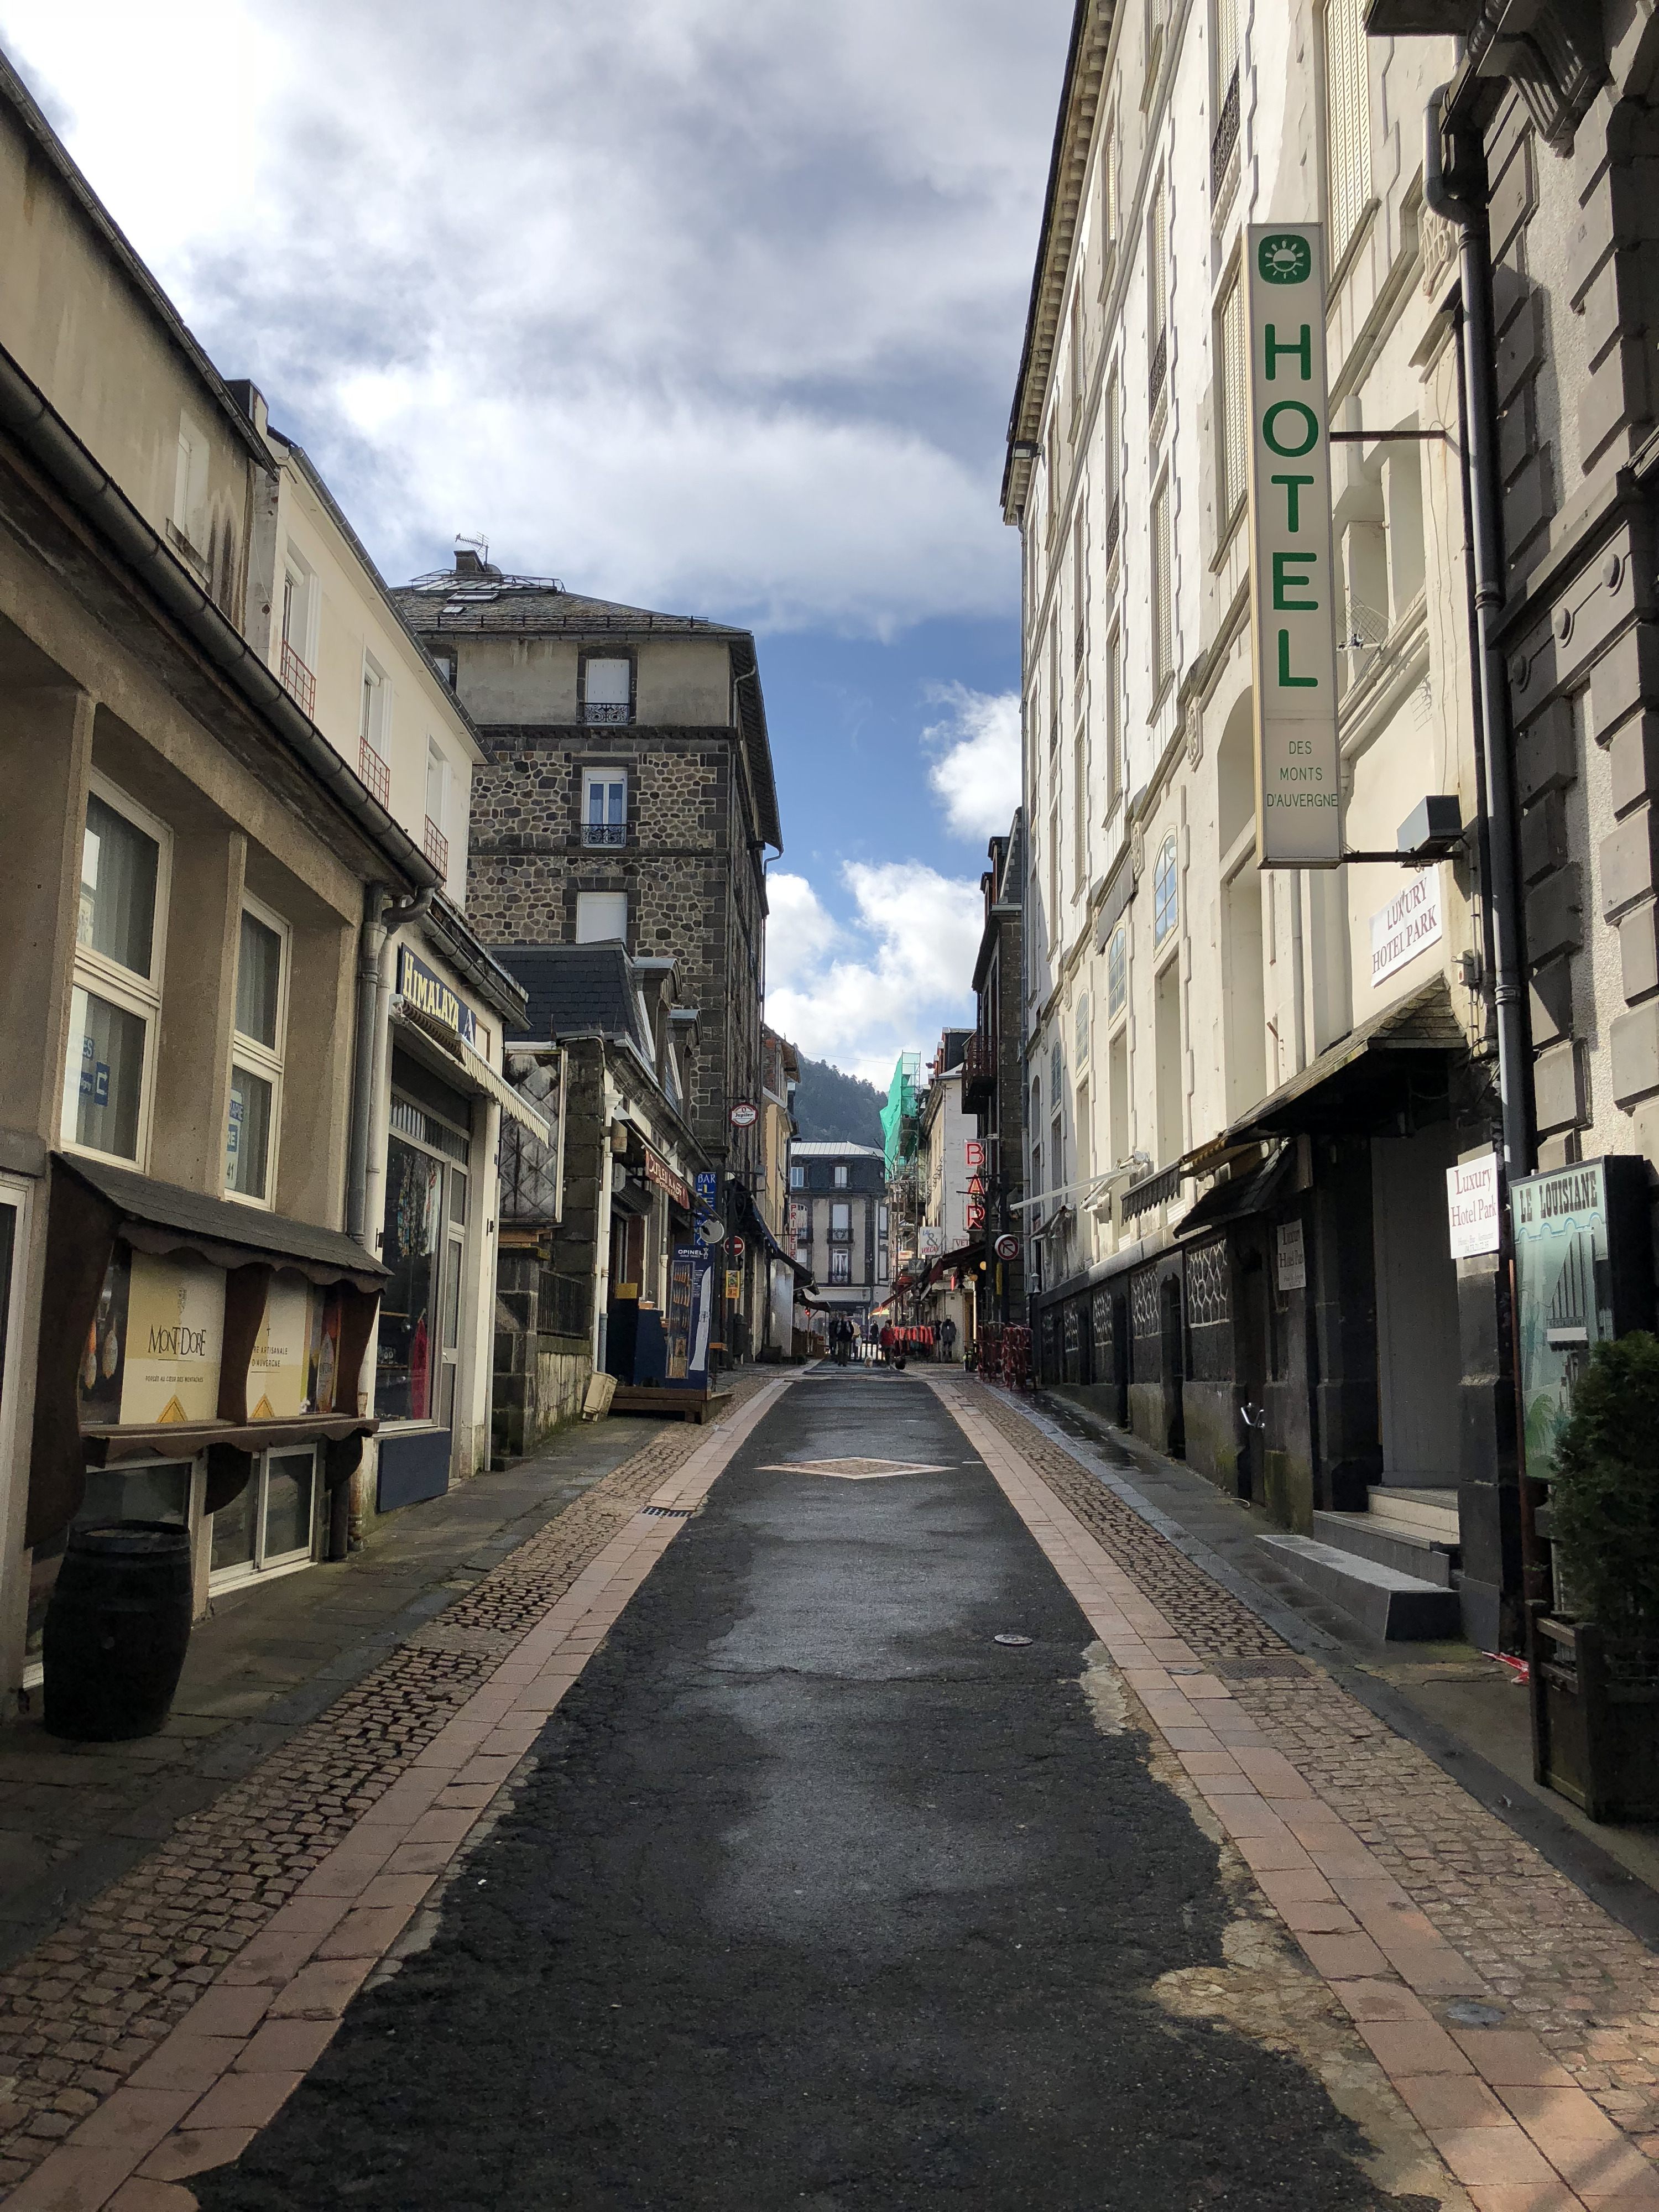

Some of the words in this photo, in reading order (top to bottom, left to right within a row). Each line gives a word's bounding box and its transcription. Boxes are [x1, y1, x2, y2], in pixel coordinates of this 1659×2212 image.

[1262, 323, 1319, 687] HOTEL
[1288, 740, 1312, 754] DES
[1280, 767, 1323, 781] MONTS
[1266, 793, 1339, 807] D'AUVERGNE
[1387, 877, 1427, 931] LUXURY
[1372, 931, 1405, 974] HOTEL
[1406, 904, 1437, 948] PARK
[403, 951, 459, 1033] HIMALAYA
[698, 1173, 716, 1183] BAR
[966, 1142, 985, 1229] BAR
[1454, 1168, 1492, 1195] Luxury
[1451, 1200, 1477, 1227] Hotel
[1478, 1194, 1496, 1220] Park
[1519, 1187, 1533, 1223] LE
[1538, 1170, 1598, 1219] LOUISIANE
[252, 1359, 280, 1367] D'AUVERGNE
[260, 1346, 288, 1355] ARTISANALE
